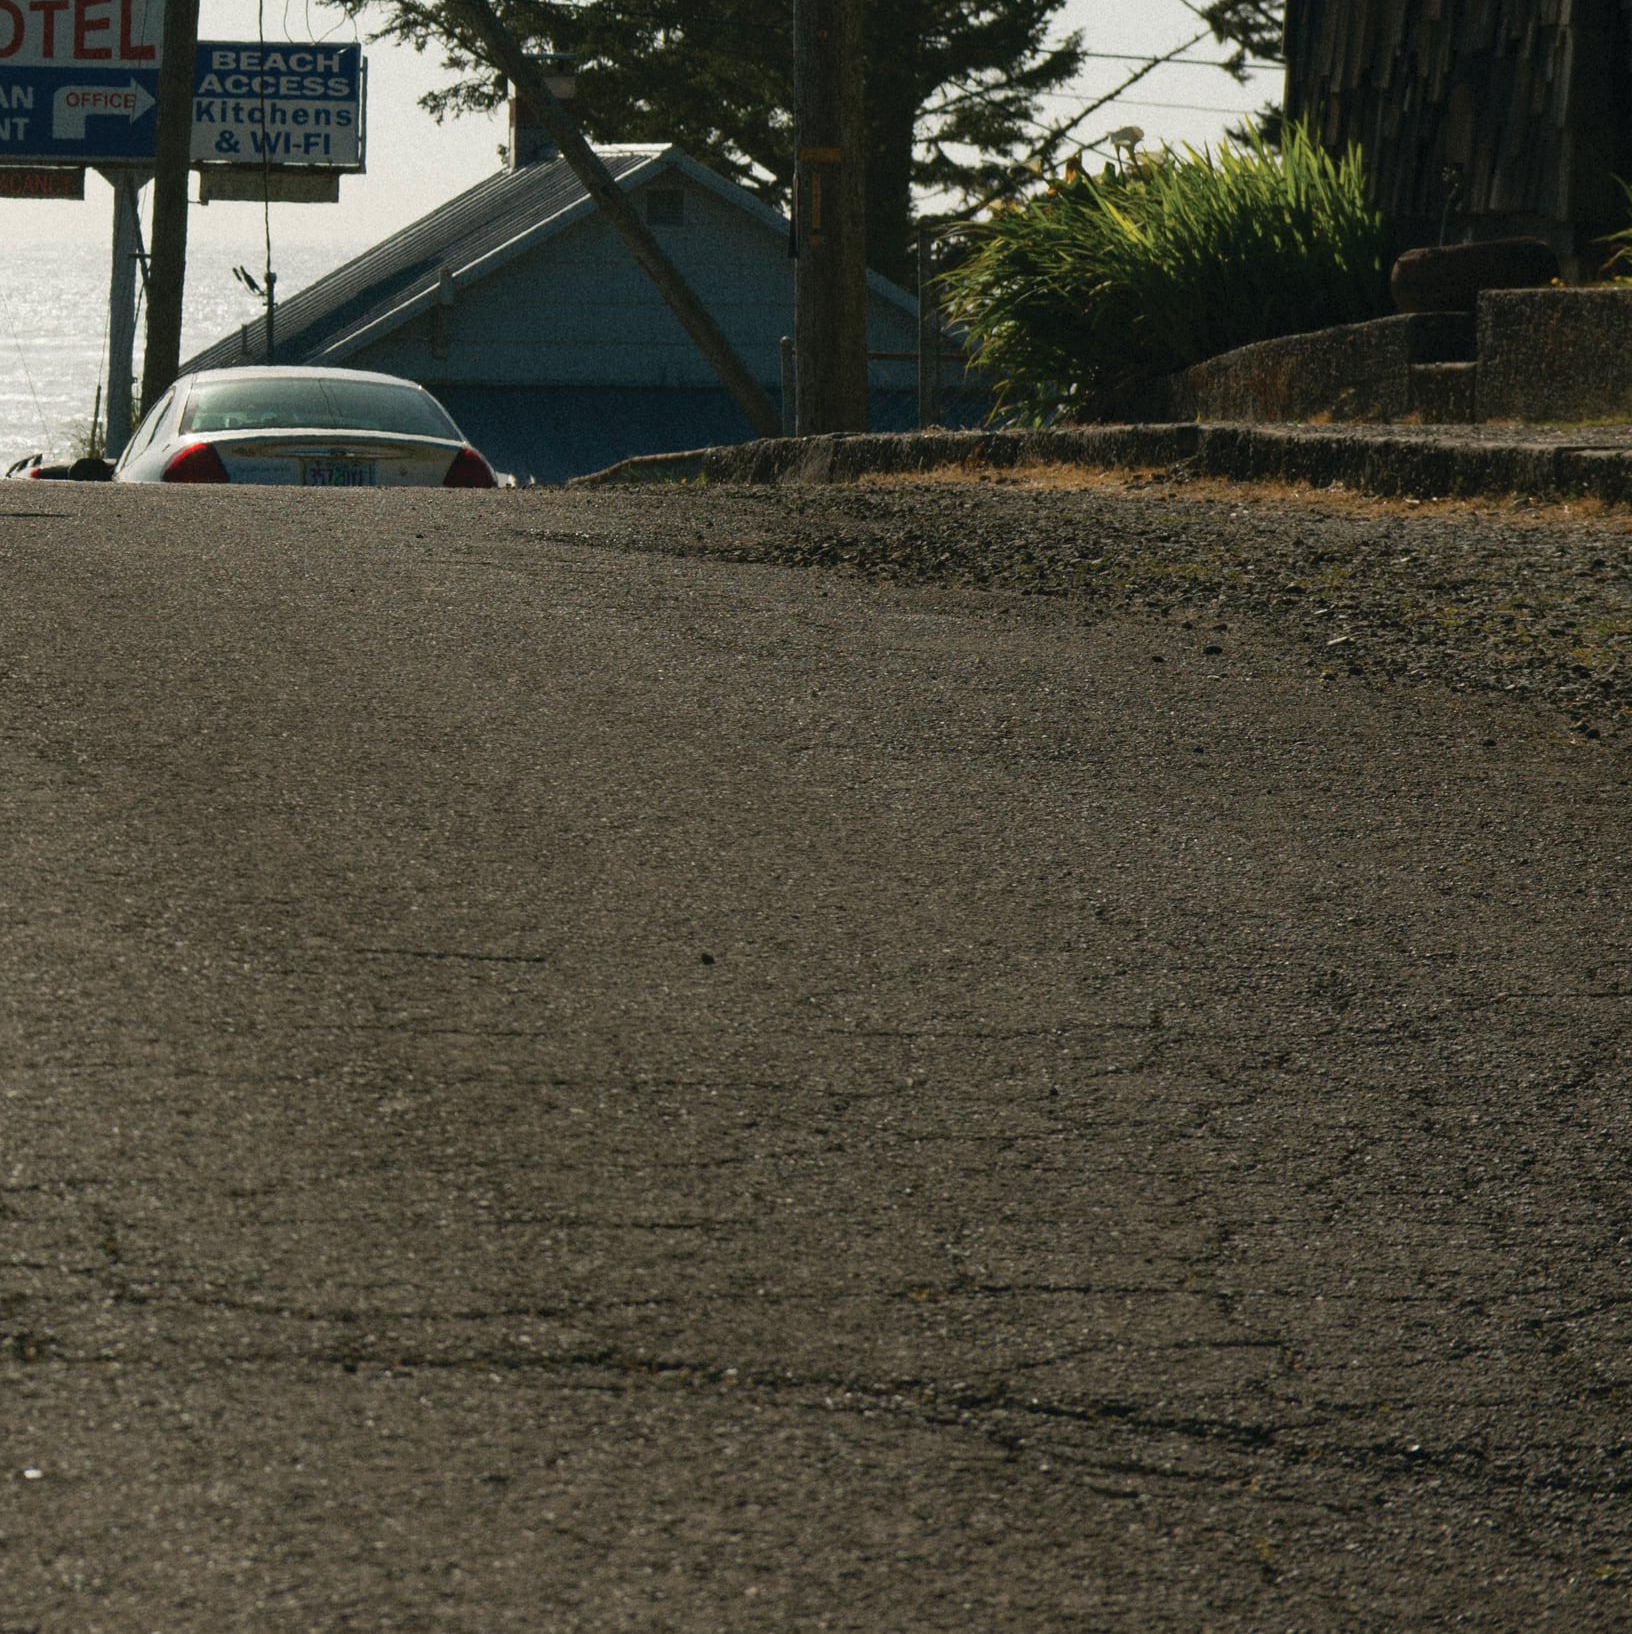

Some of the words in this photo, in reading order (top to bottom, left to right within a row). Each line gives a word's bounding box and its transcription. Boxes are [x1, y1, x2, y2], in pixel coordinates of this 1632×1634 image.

[211, 51, 340, 73] BEACH
[198, 73, 351, 97] ACCESS
[65, 92, 136, 109] OFFICE
[195, 100, 353, 127] Kitchens
[214, 129, 241, 154] &
[250, 131, 331, 156] WI-FI
